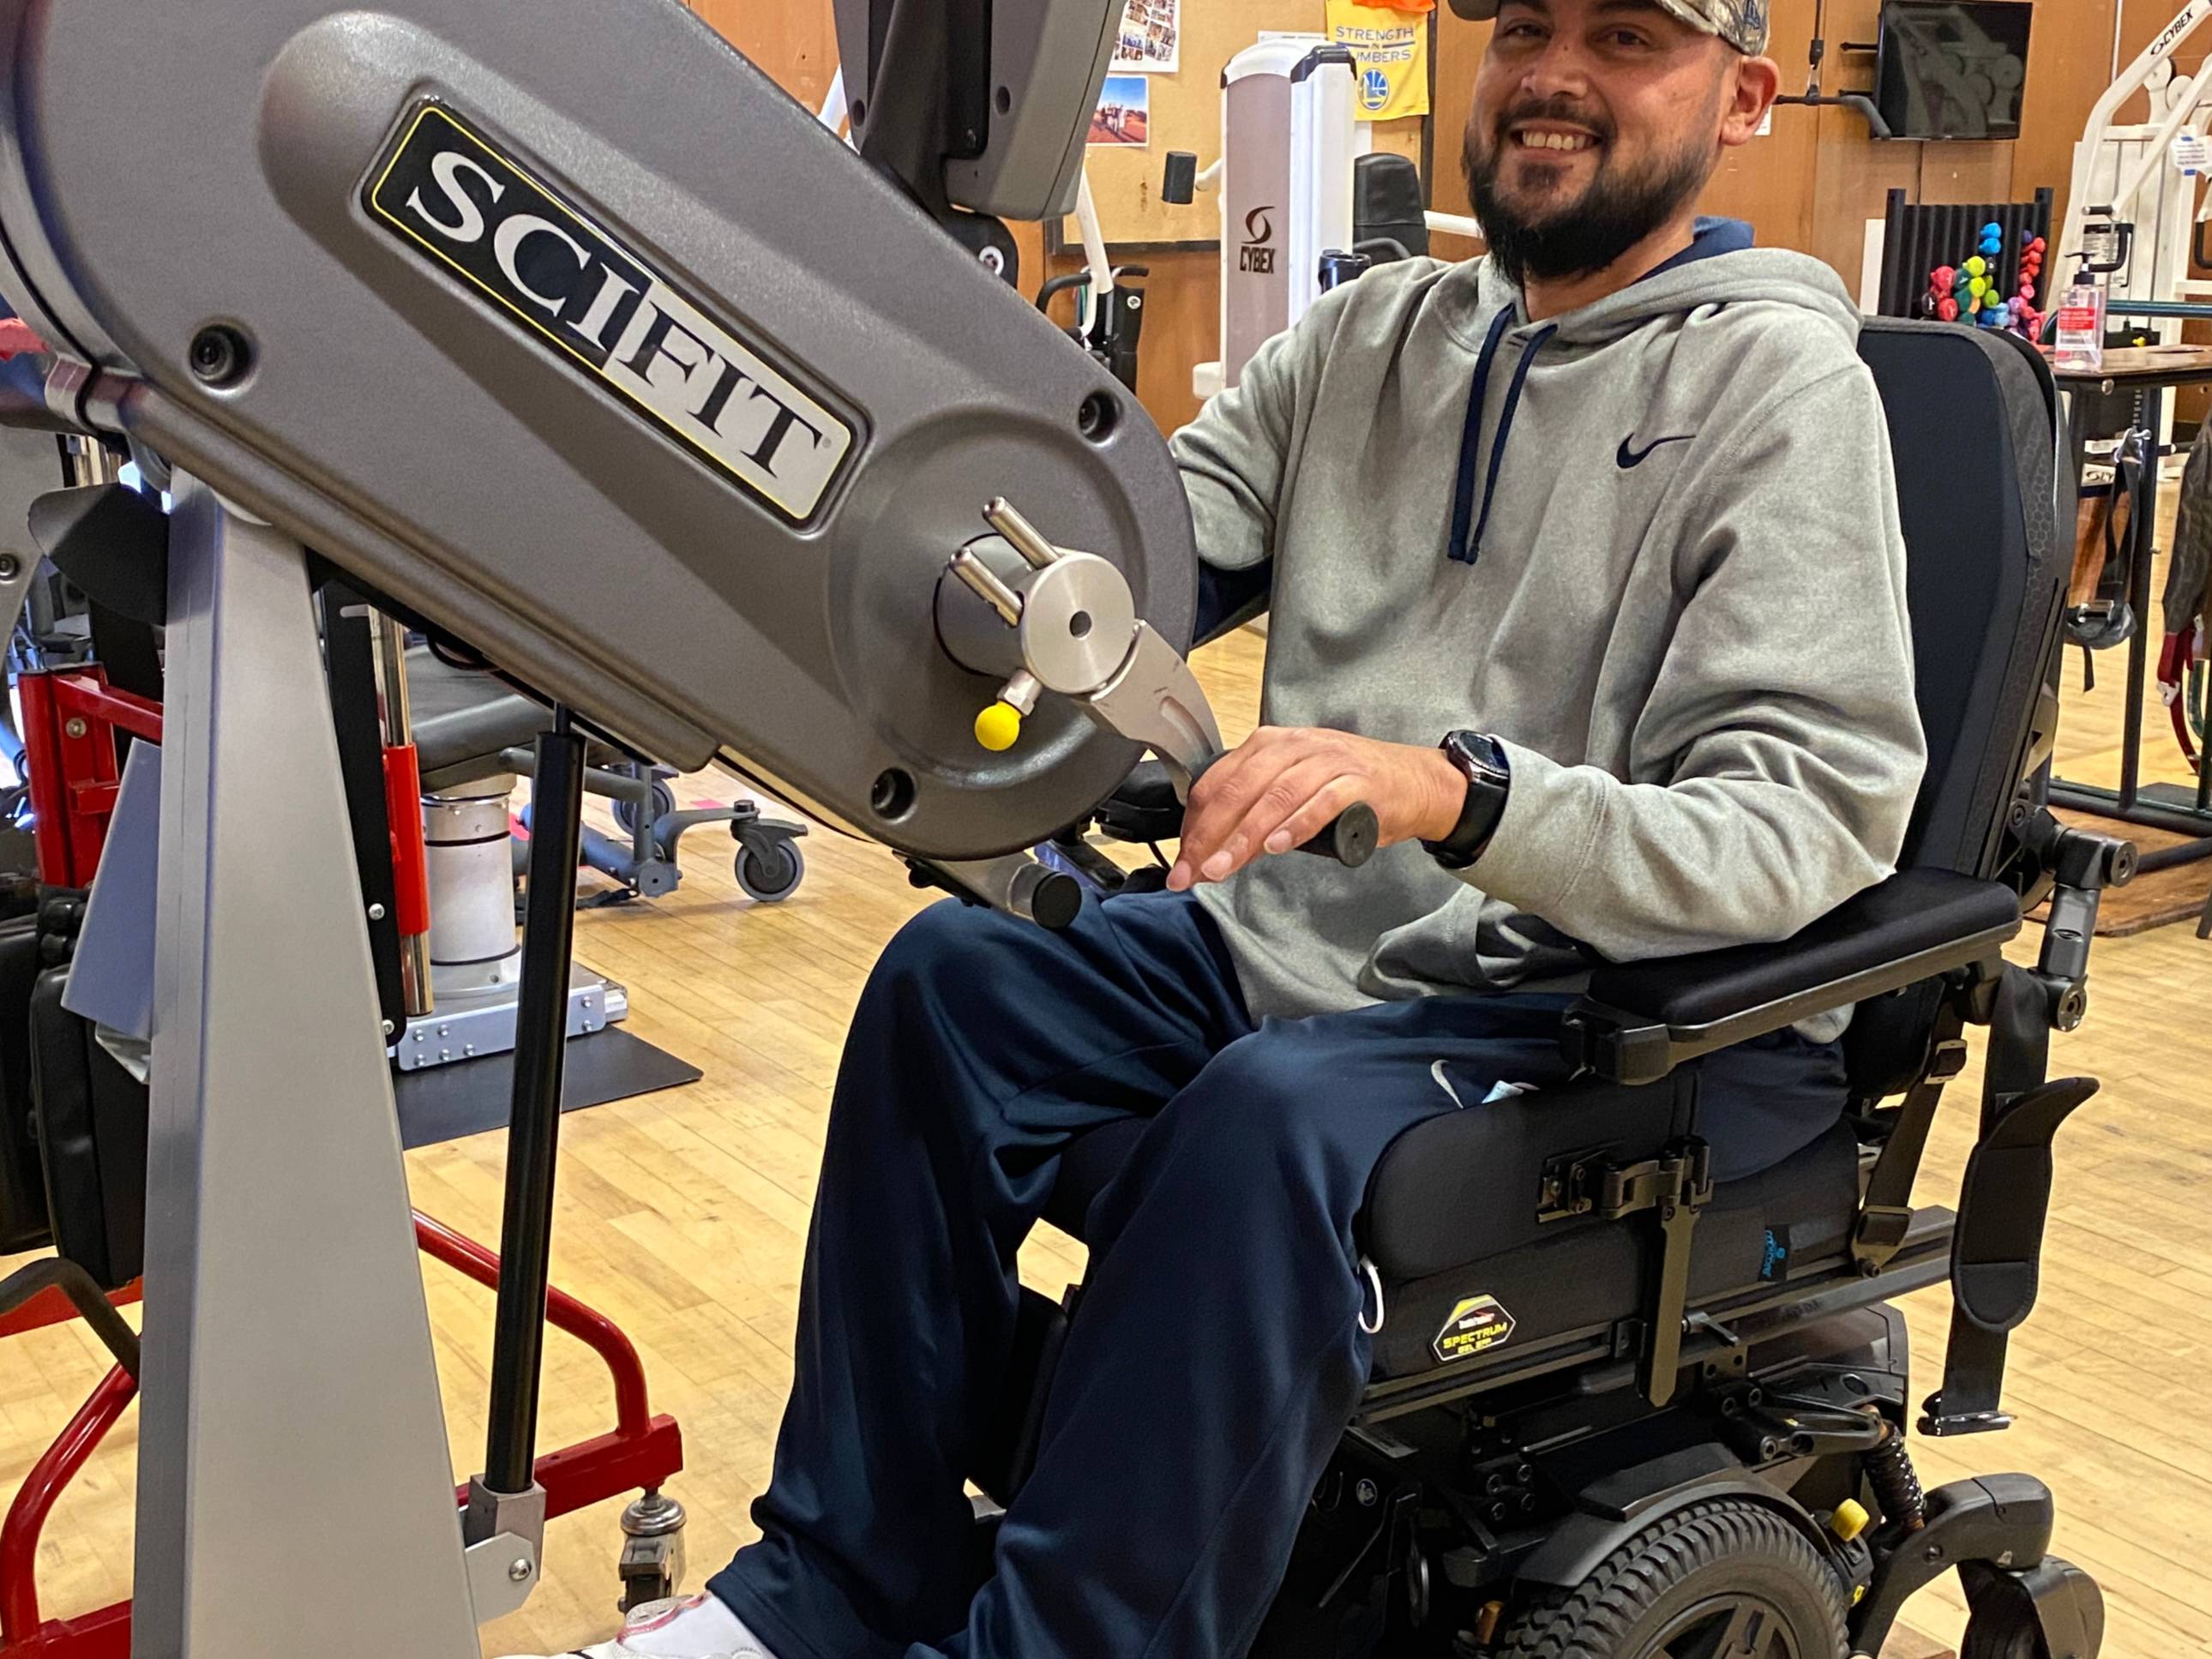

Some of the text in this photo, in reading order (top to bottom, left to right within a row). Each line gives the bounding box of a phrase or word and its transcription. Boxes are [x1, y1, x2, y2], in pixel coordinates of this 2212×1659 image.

[1336, 26, 1414, 41] STRENGTH
[2163, 7, 2193, 45] CYBEX
[1240, 246, 1275, 274] CYBEX
[405, 150, 823, 479] SCIFIT
[1443, 1321, 1507, 1349] SPECTRUM
